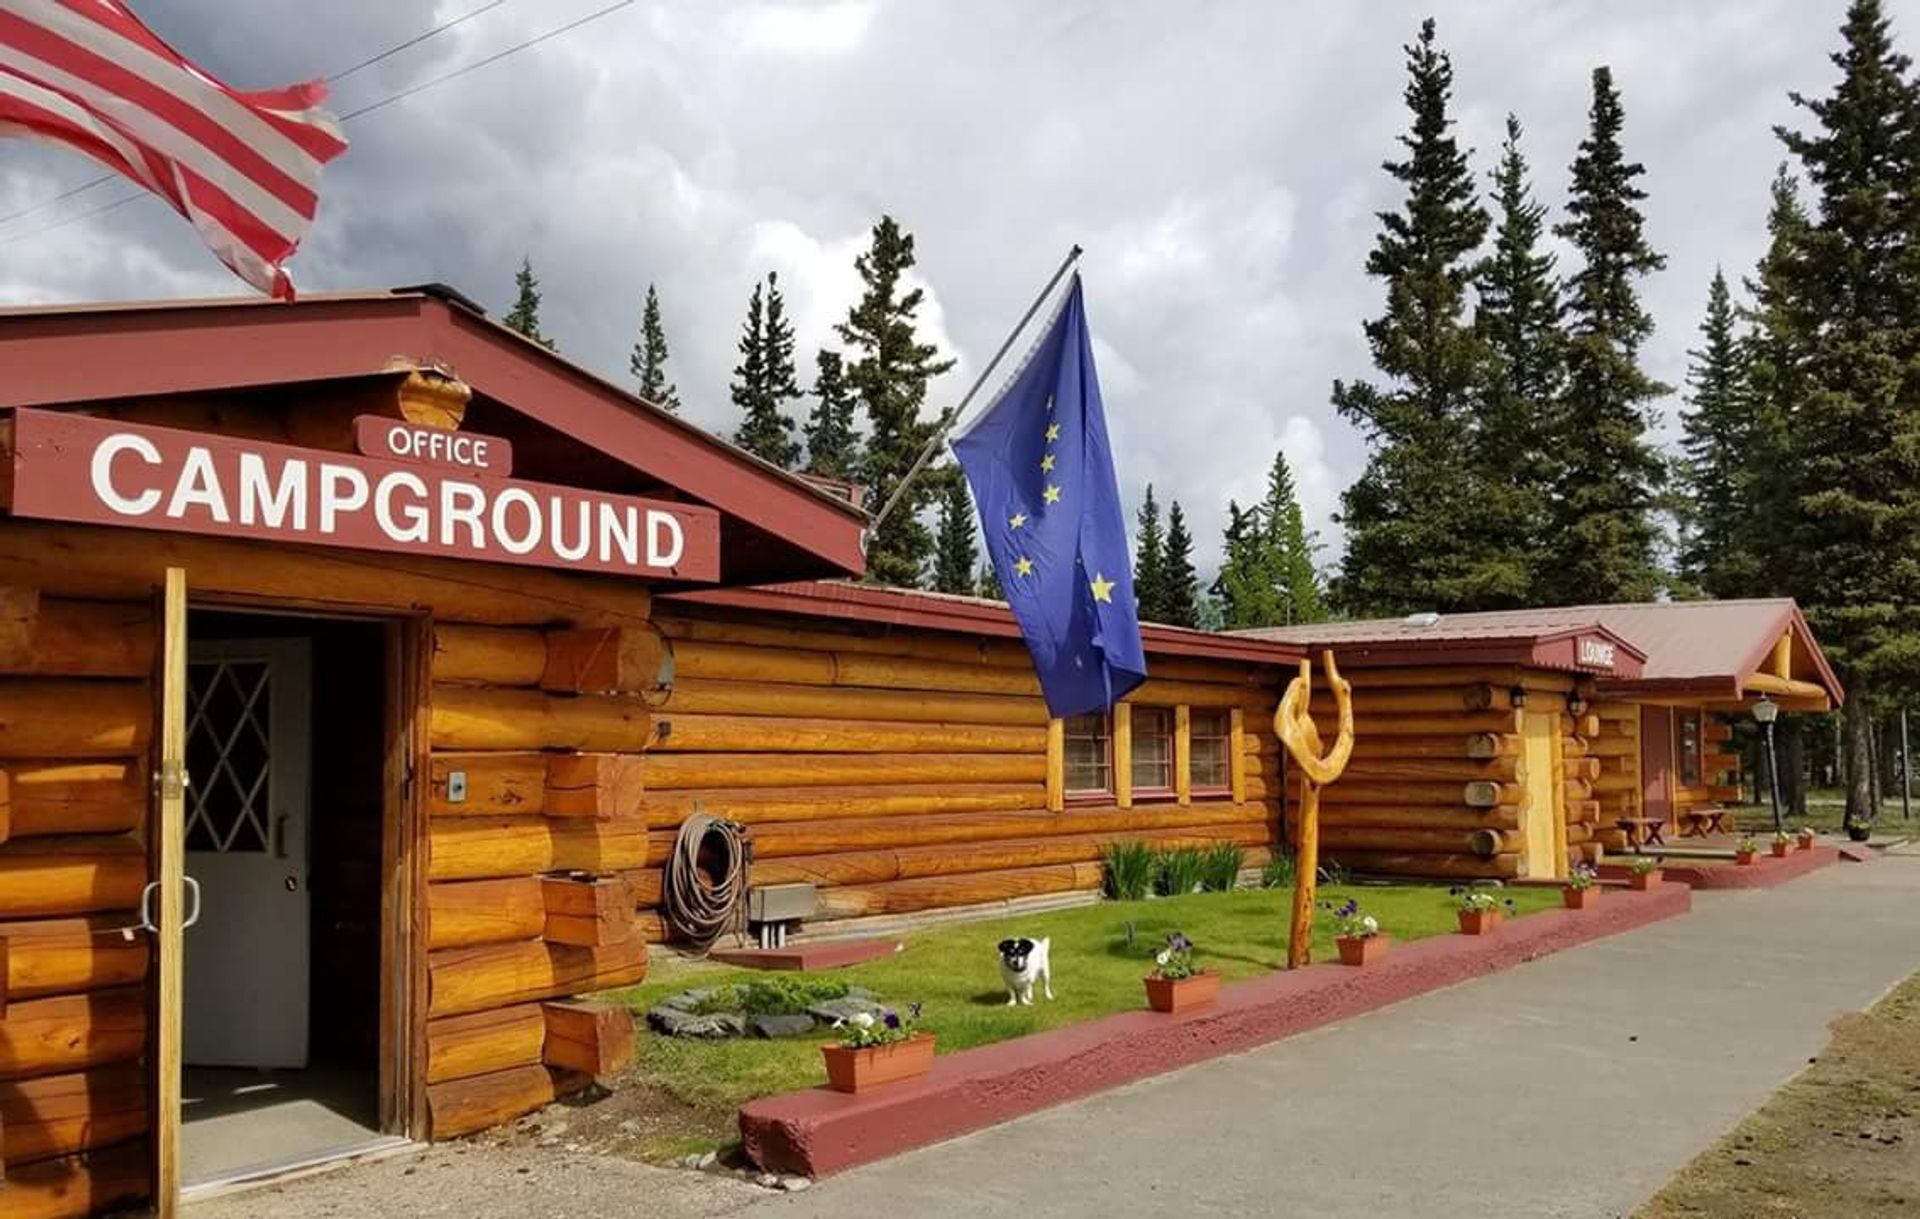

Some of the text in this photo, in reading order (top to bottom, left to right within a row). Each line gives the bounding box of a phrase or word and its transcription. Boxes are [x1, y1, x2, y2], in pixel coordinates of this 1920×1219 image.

[388, 427, 488, 467] OFFICE
[91, 434, 684, 567] CAMPGROUND
[1581, 641, 1614, 666] LOUNGE
